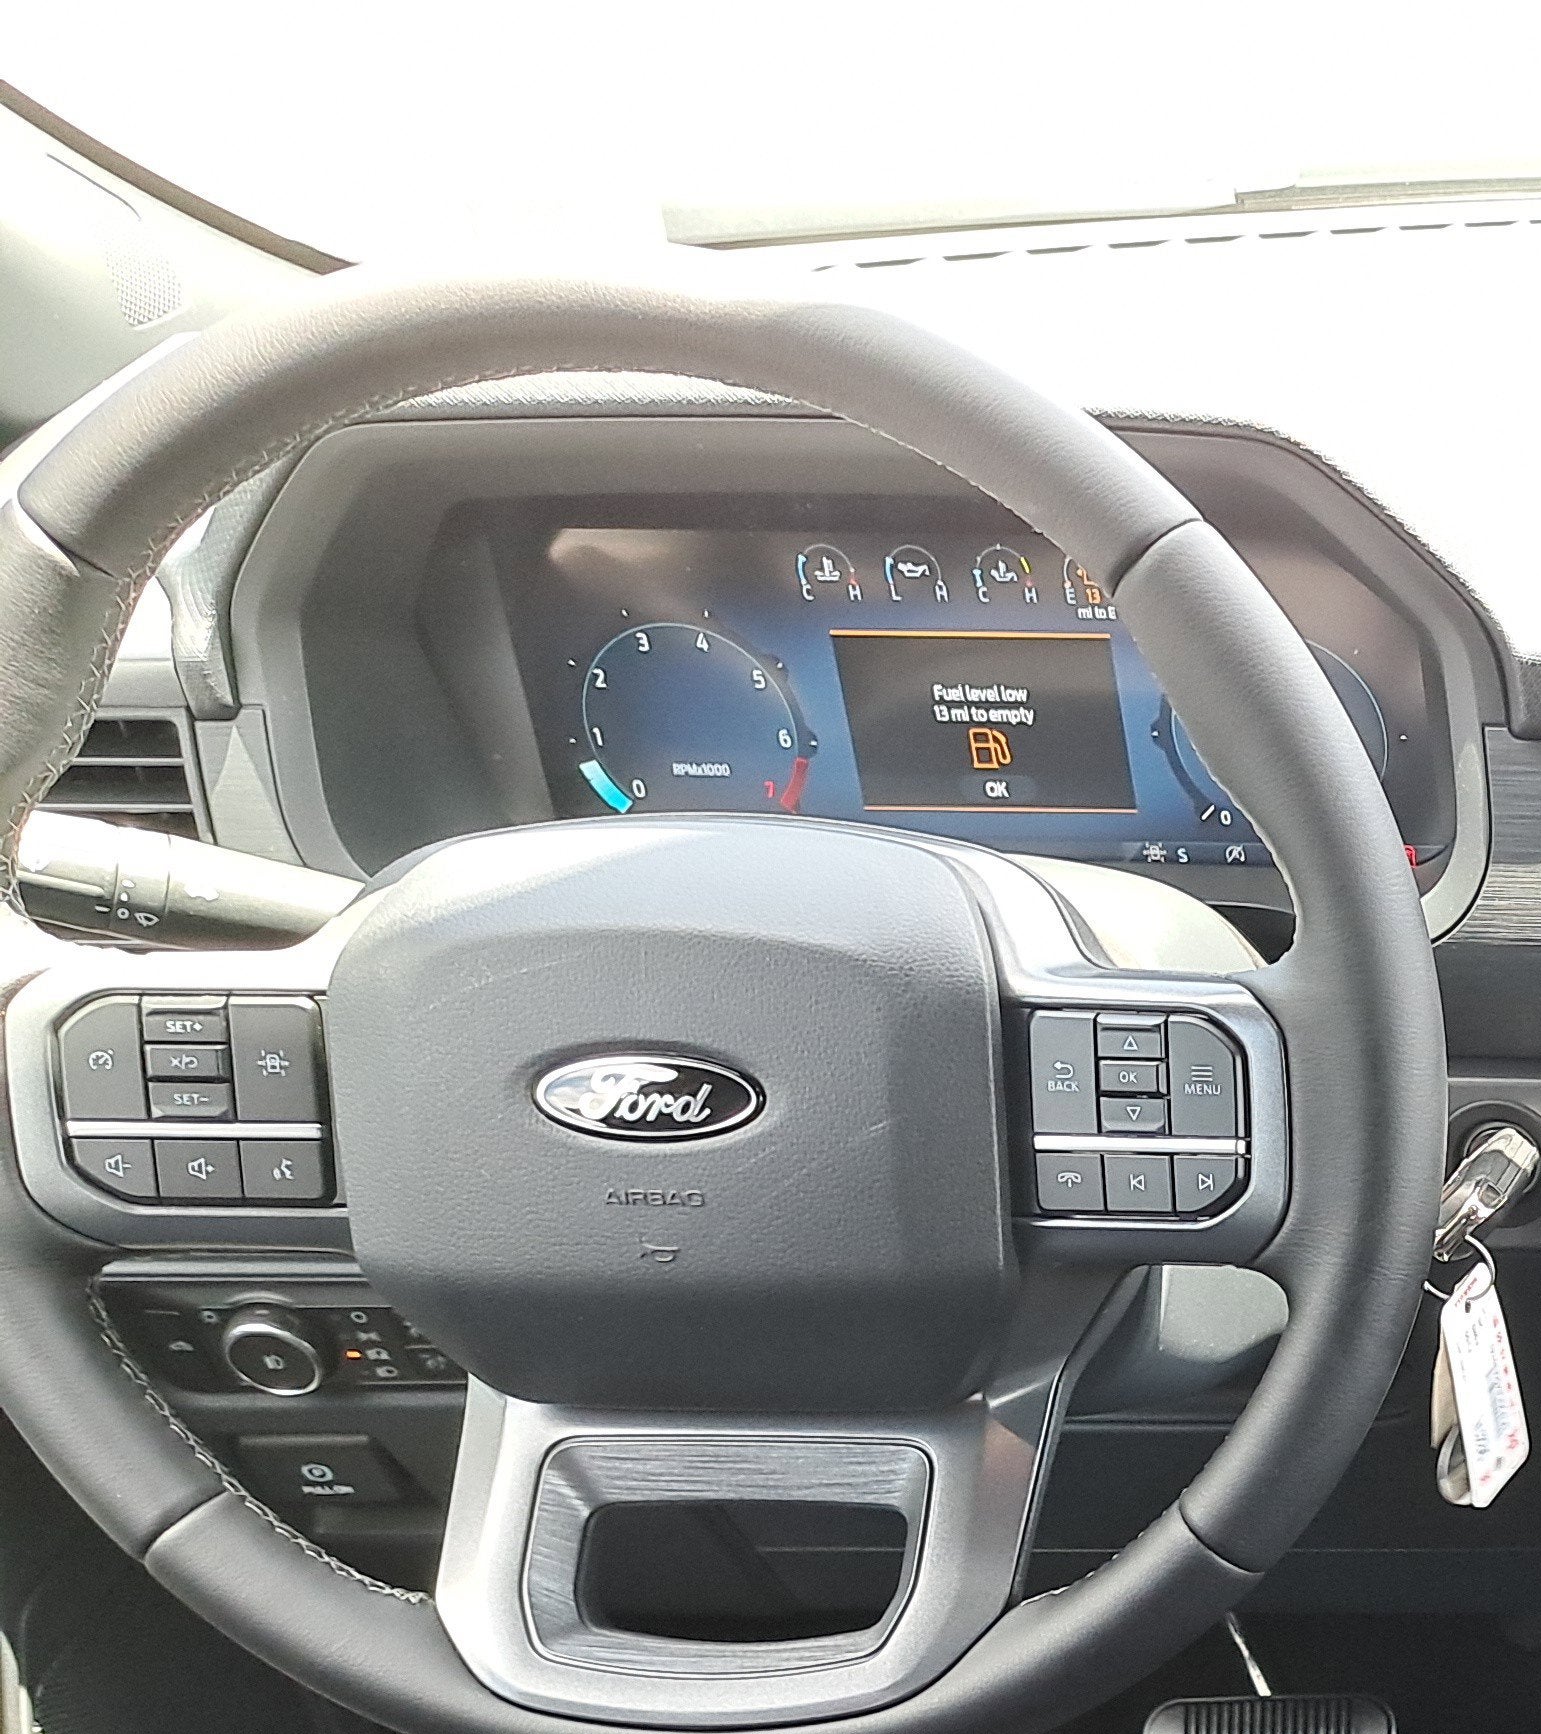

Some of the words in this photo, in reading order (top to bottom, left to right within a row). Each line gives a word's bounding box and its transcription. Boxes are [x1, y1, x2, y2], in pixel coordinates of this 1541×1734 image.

[1086, 588, 1101, 603] 13
[635, 632, 650, 652] 3
[695, 632, 709, 652] 4
[592, 668, 608, 688] 2
[752, 669, 766, 689] 5
[932, 684, 962, 701] Fuel
[965, 684, 1000, 702] level
[1001, 686, 1028, 702] low
[934, 704, 949, 722] 13
[951, 706, 970, 722] mi
[971, 707, 987, 722] to
[989, 707, 1034, 725] empty
[592, 727, 604, 746] 1
[777, 728, 792, 749] 6
[632, 778, 647, 798] 0
[763, 780, 775, 798] 7
[985, 781, 1010, 797] OK
[1220, 810, 1231, 826] 0
[1048, 1081, 1079, 1092] BACK
[1119, 1072, 1137, 1083] OK
[578, 1063, 712, 1122] Ford
[1184, 1084, 1221, 1095] MENU
[606, 1189, 705, 1207] AIRBAG
